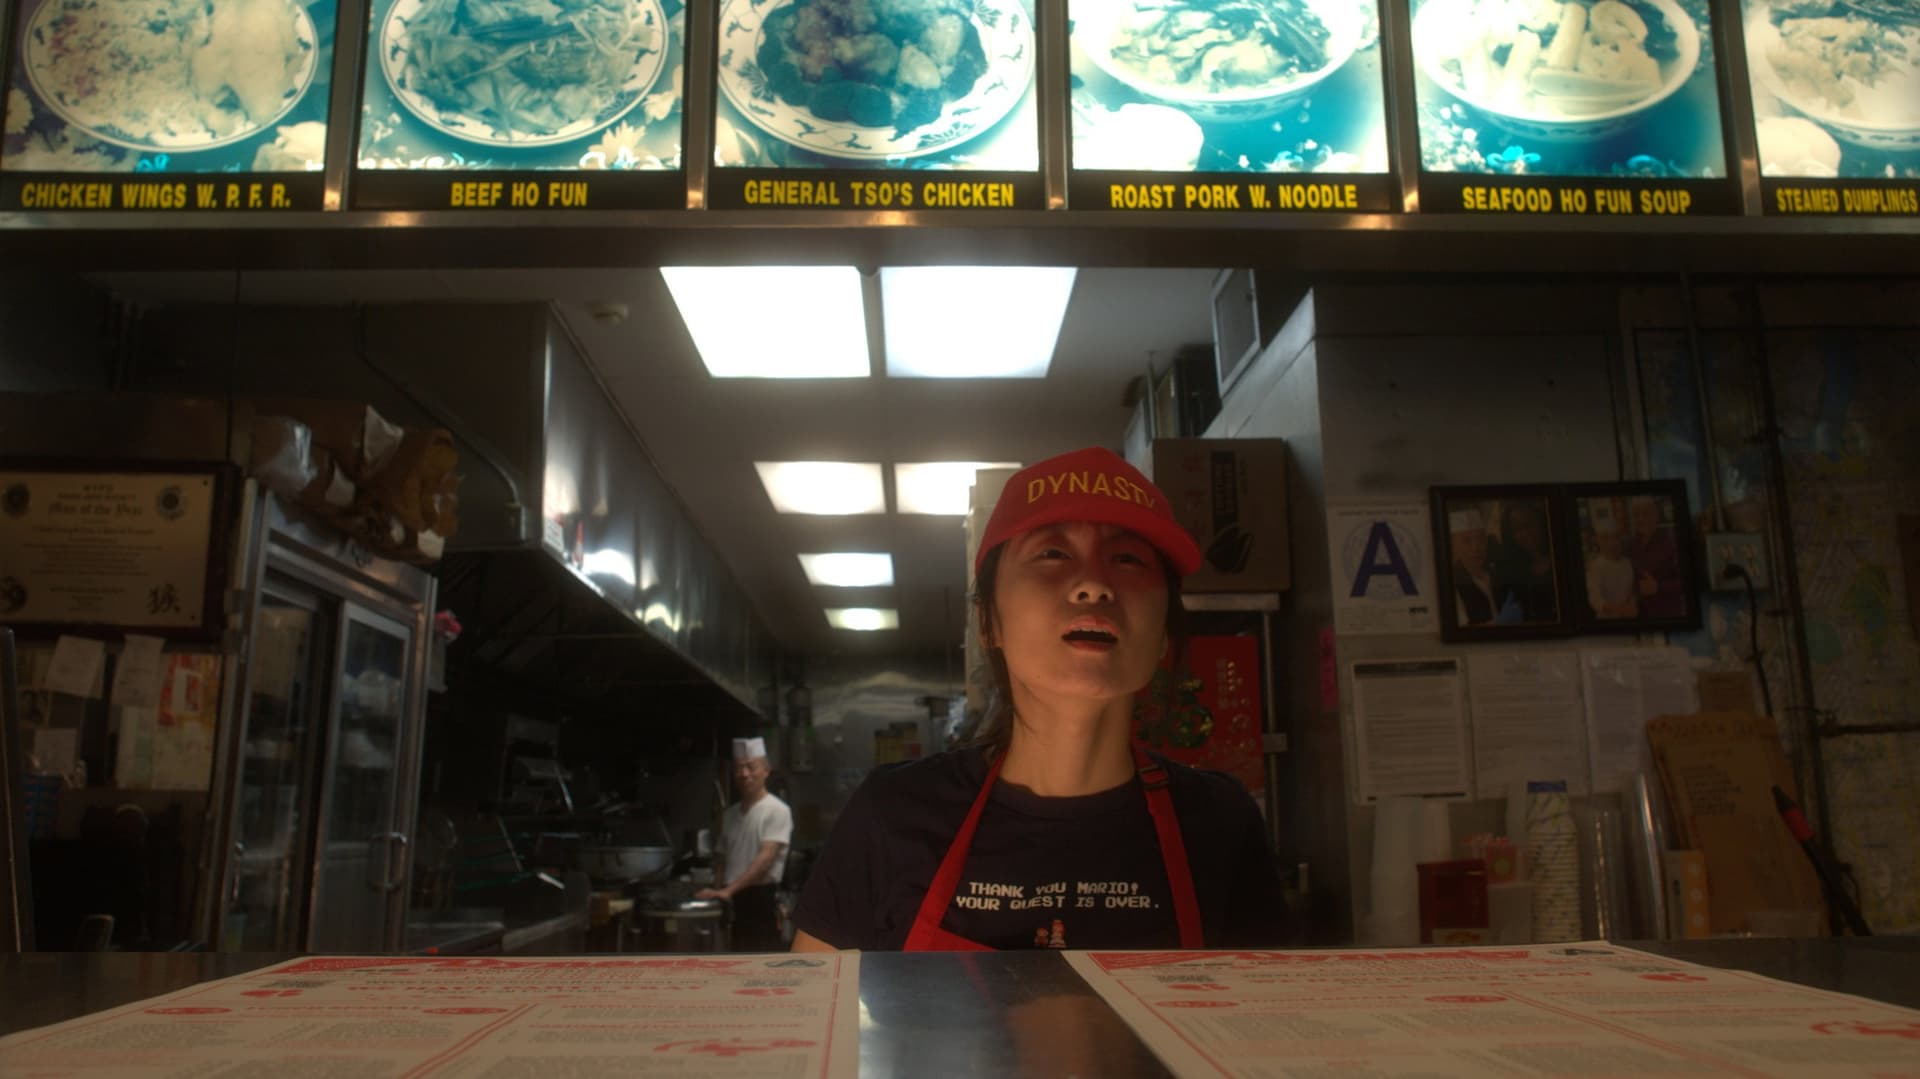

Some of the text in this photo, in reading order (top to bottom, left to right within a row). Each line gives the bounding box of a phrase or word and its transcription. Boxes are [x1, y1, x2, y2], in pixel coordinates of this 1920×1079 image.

[22, 183, 112, 208] CHICKEN
[122, 183, 187, 208] WINGS
[196, 183, 218, 208] W.
[271, 183, 291, 208] R.
[450, 182, 588, 207] BEEF HO FUN
[744, 180, 1015, 208] GENERAL TSO'S CHICKEN
[1109, 183, 1359, 209] ROAST PORK W. NOODLE
[1462, 186, 1691, 214] SEAFOOD HO FUN SOUP
[1776, 188, 1918, 214] STEAMED DUMPLINGS
[1350, 521, 1419, 597] A
[968, 881, 1140, 898] THANK YOU MARIO!
[956, 895, 1160, 911] YOUR QUEST IS OVER.
